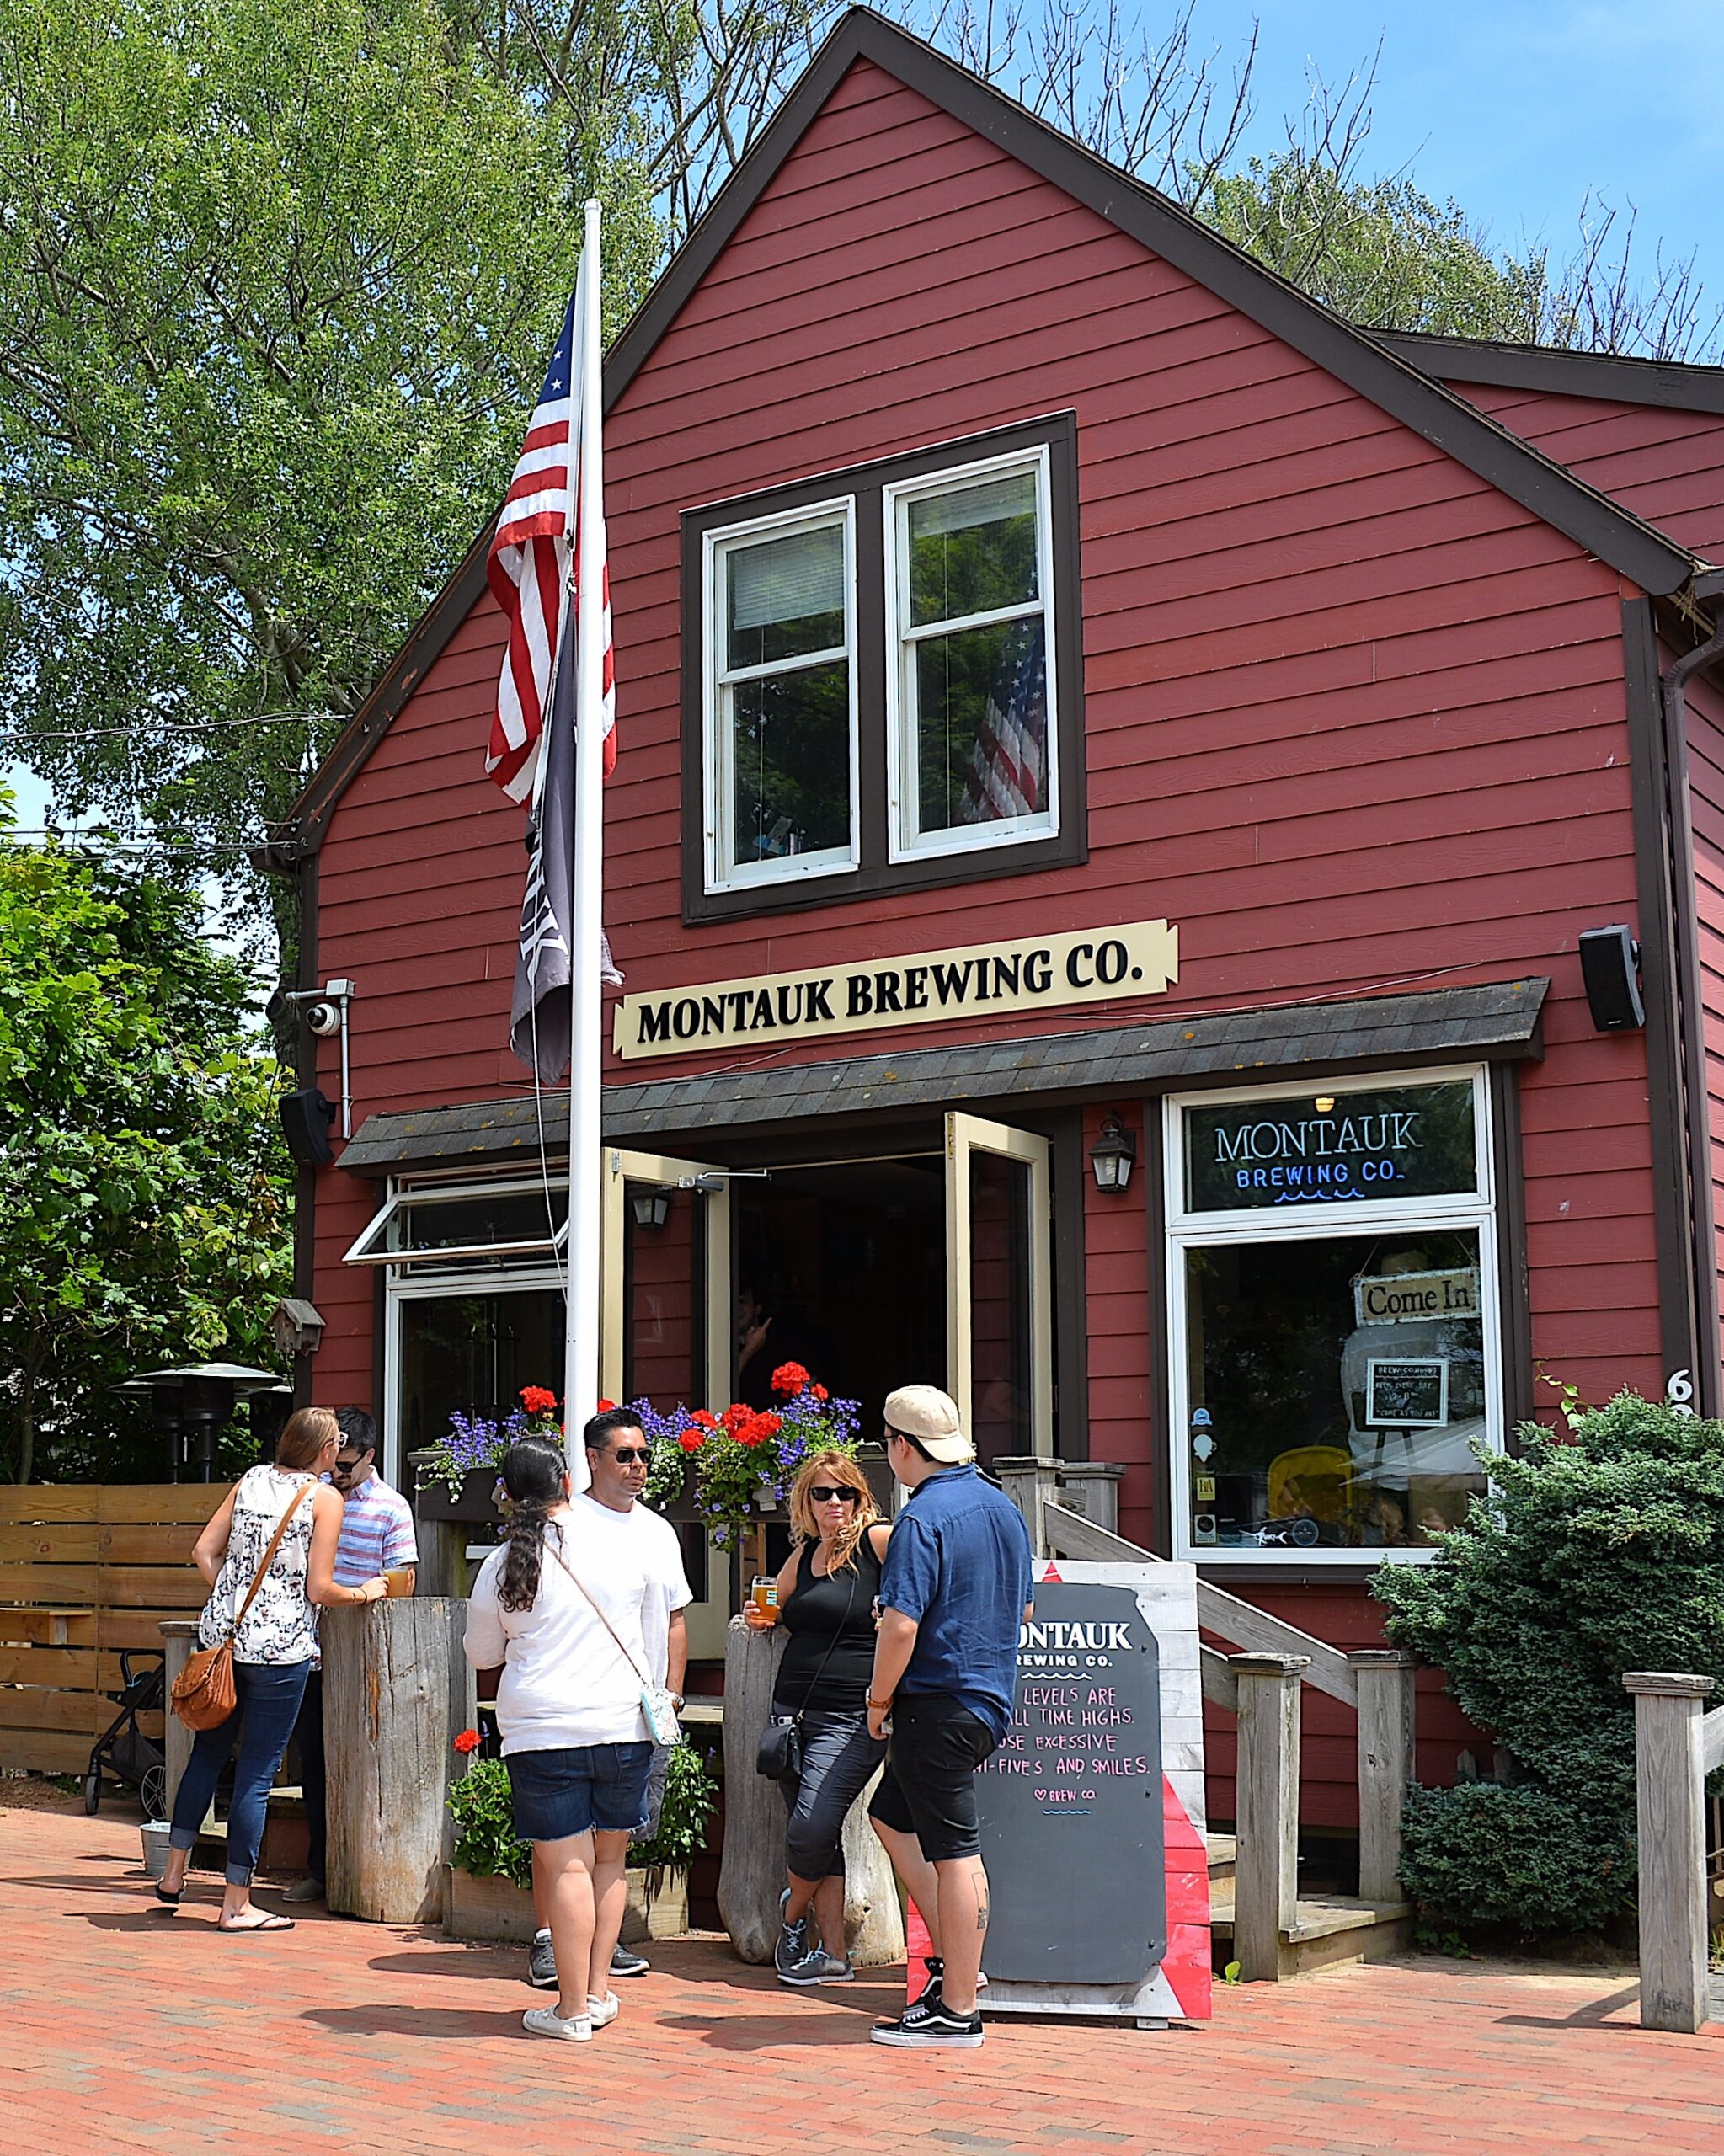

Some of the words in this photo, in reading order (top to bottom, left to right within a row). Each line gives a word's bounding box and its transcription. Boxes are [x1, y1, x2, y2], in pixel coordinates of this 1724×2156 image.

[637, 979, 835, 1043] MONTAUK
[846, 950, 1053, 1017] BREWING
[1066, 940, 1143, 988] CO.
[1214, 1112, 1424, 1161] MONTAUK
[1237, 1164, 1348, 1187] BREWING
[1367, 1286, 1438, 1315] Come
[1442, 1280, 1470, 1309] In
[1016, 1654, 1078, 1667] REWING
[1085, 1655, 1113, 1667] CO.
[1023, 1687, 1078, 1705] LEVELS
[1087, 1687, 1117, 1706] ARE
[1011, 1709, 1030, 1727] LL
[1039, 1708, 1075, 1726] TIME
[1081, 1708, 1135, 1727] HIGHS.
[1036, 1733, 1119, 1752] EXCESSIVE
[1056, 1757, 1086, 1775] AND
[1092, 1756, 1150, 1775] SMILES.
[1049, 1790, 1077, 1802] BREW
